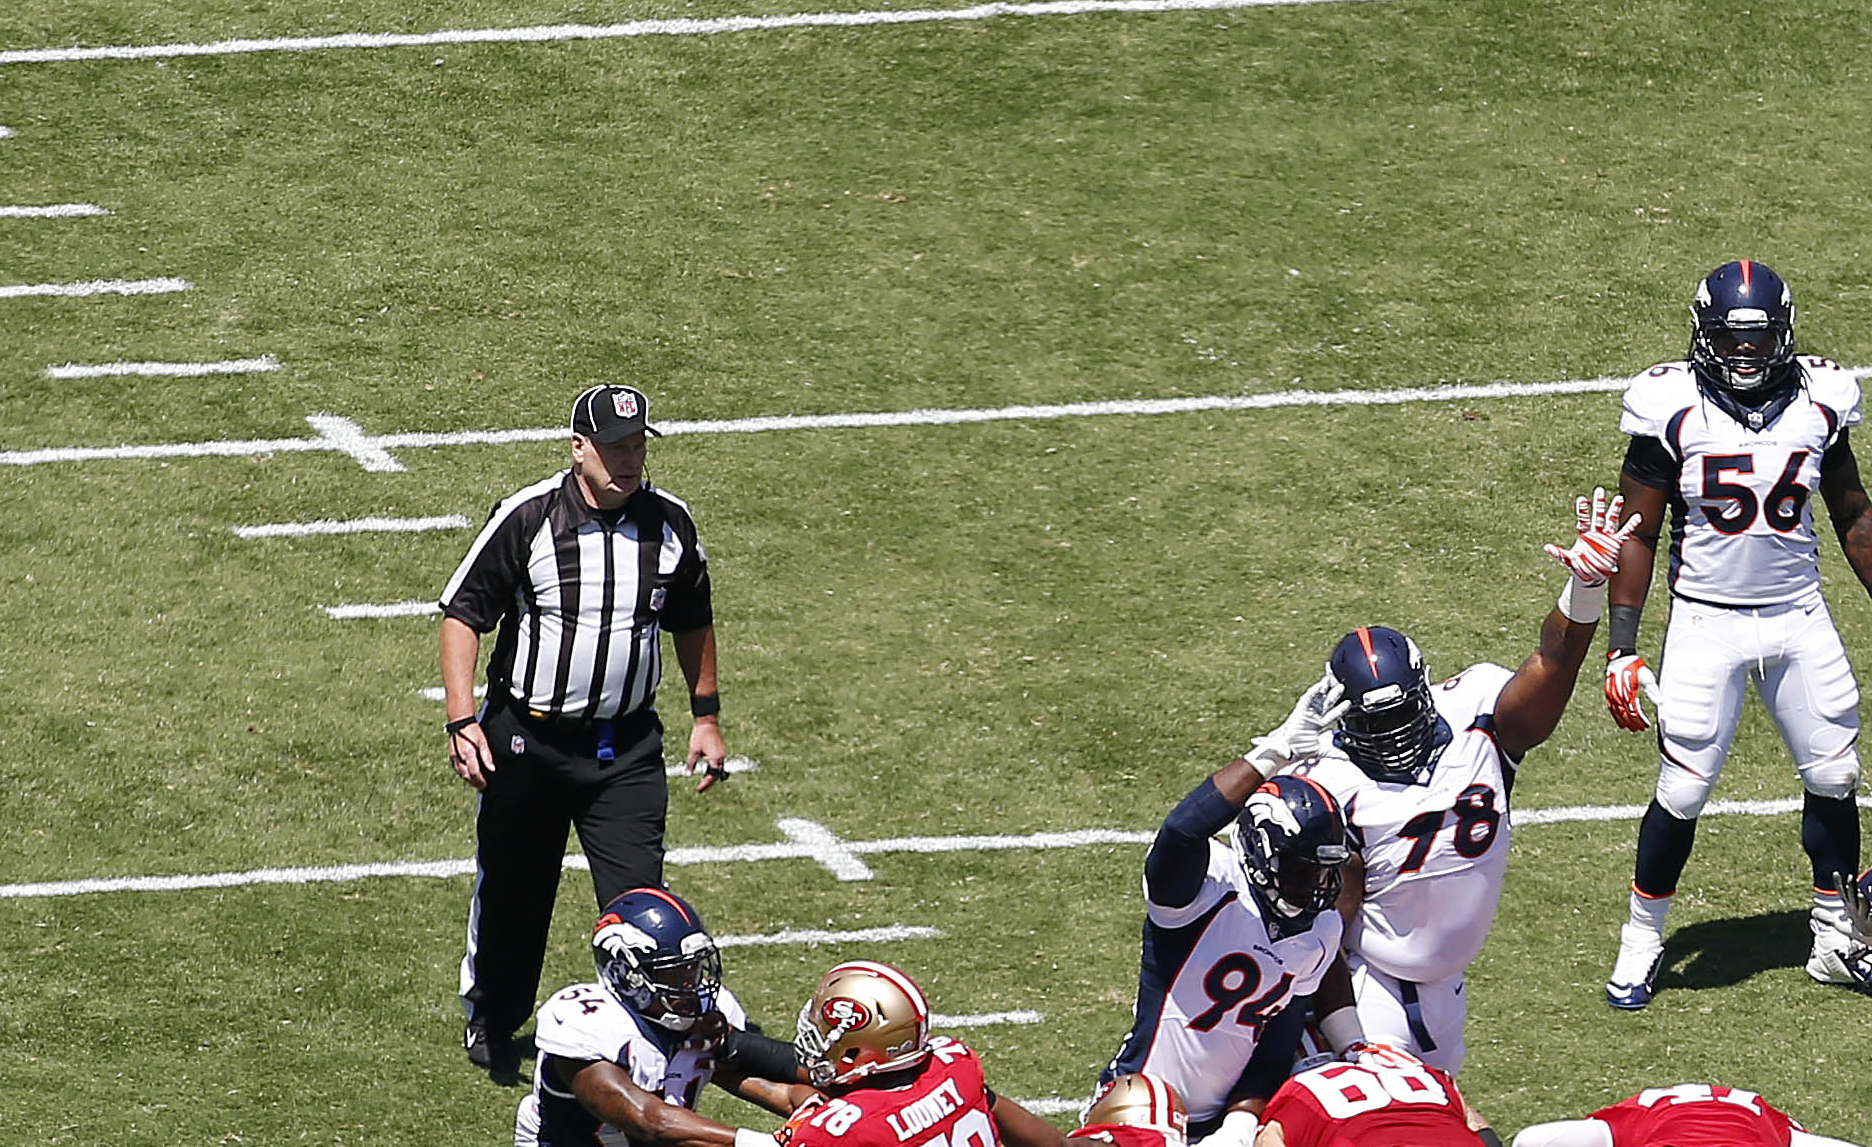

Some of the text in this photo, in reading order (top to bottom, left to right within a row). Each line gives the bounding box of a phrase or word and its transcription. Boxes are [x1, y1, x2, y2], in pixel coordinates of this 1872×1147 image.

[1699, 450, 1811, 536] 56
[1396, 783, 1501, 875] 78
[810, 1098, 863, 1137] 78
[885, 1077, 964, 1142] LOONEY
